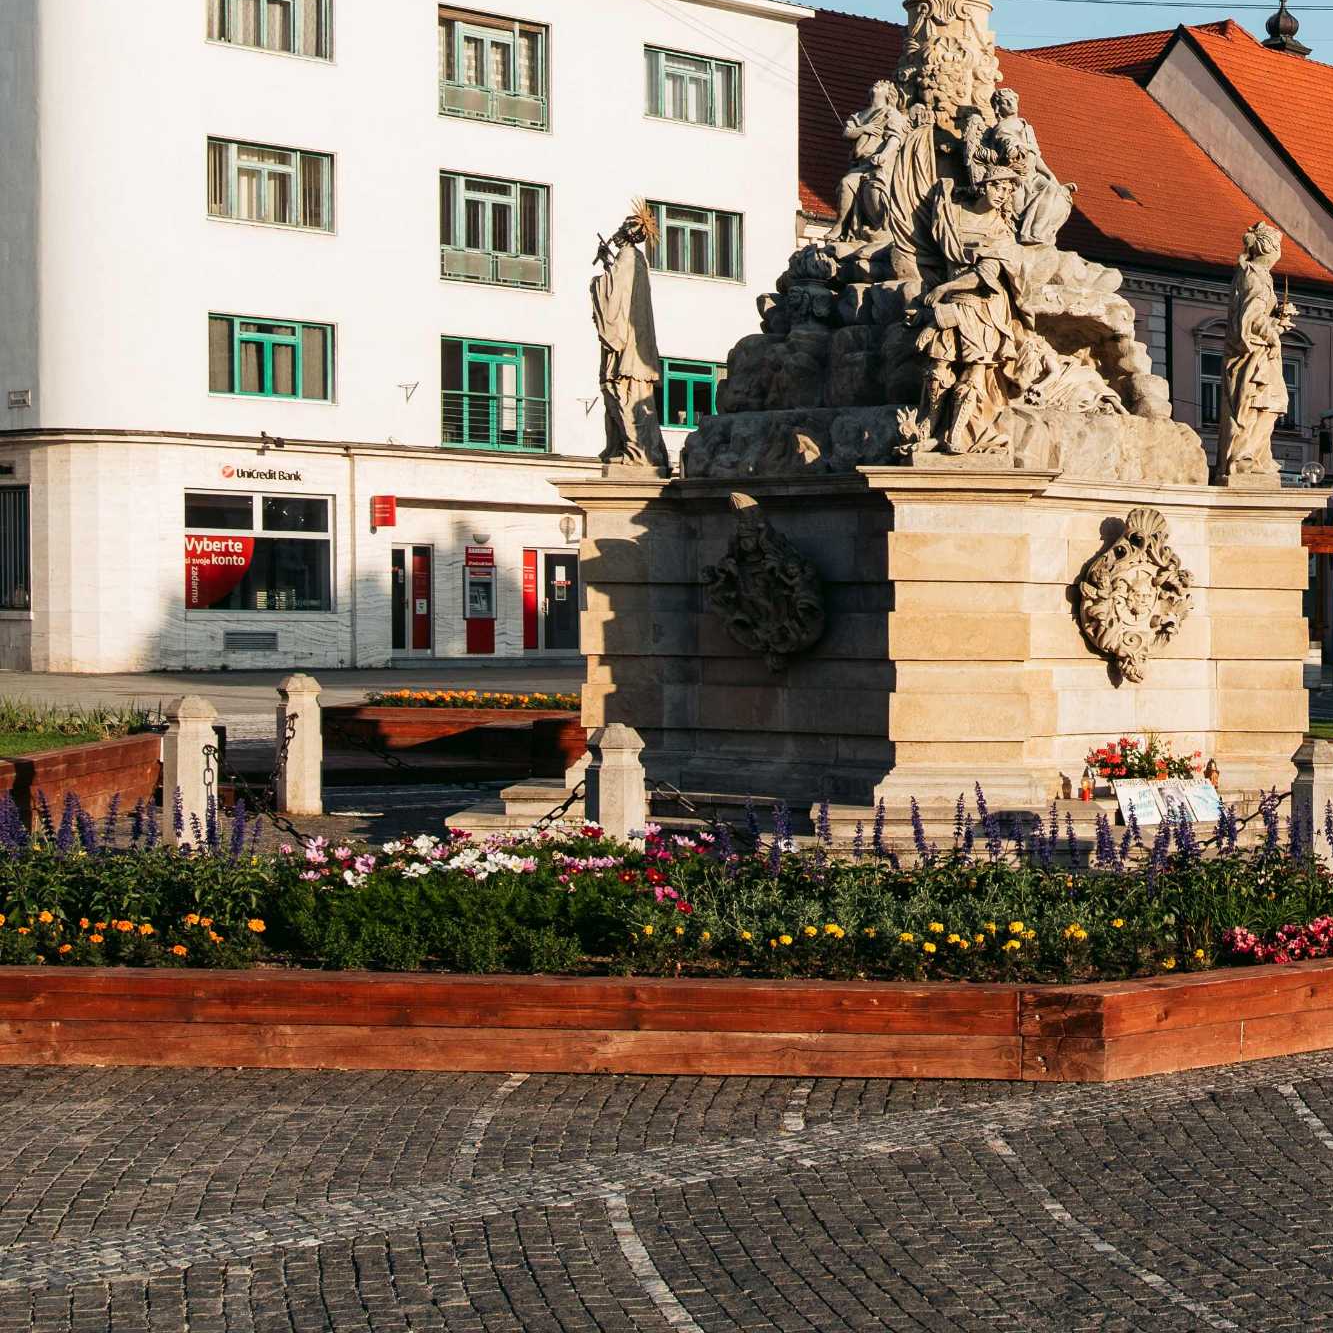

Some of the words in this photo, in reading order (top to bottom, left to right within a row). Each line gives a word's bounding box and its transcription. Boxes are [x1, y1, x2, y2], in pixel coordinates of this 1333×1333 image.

[236, 469, 277, 480] UniCredit
[278, 471, 302, 482] Bank
[185, 537, 243, 554] Vyberte
[211, 554, 246, 565] konto
